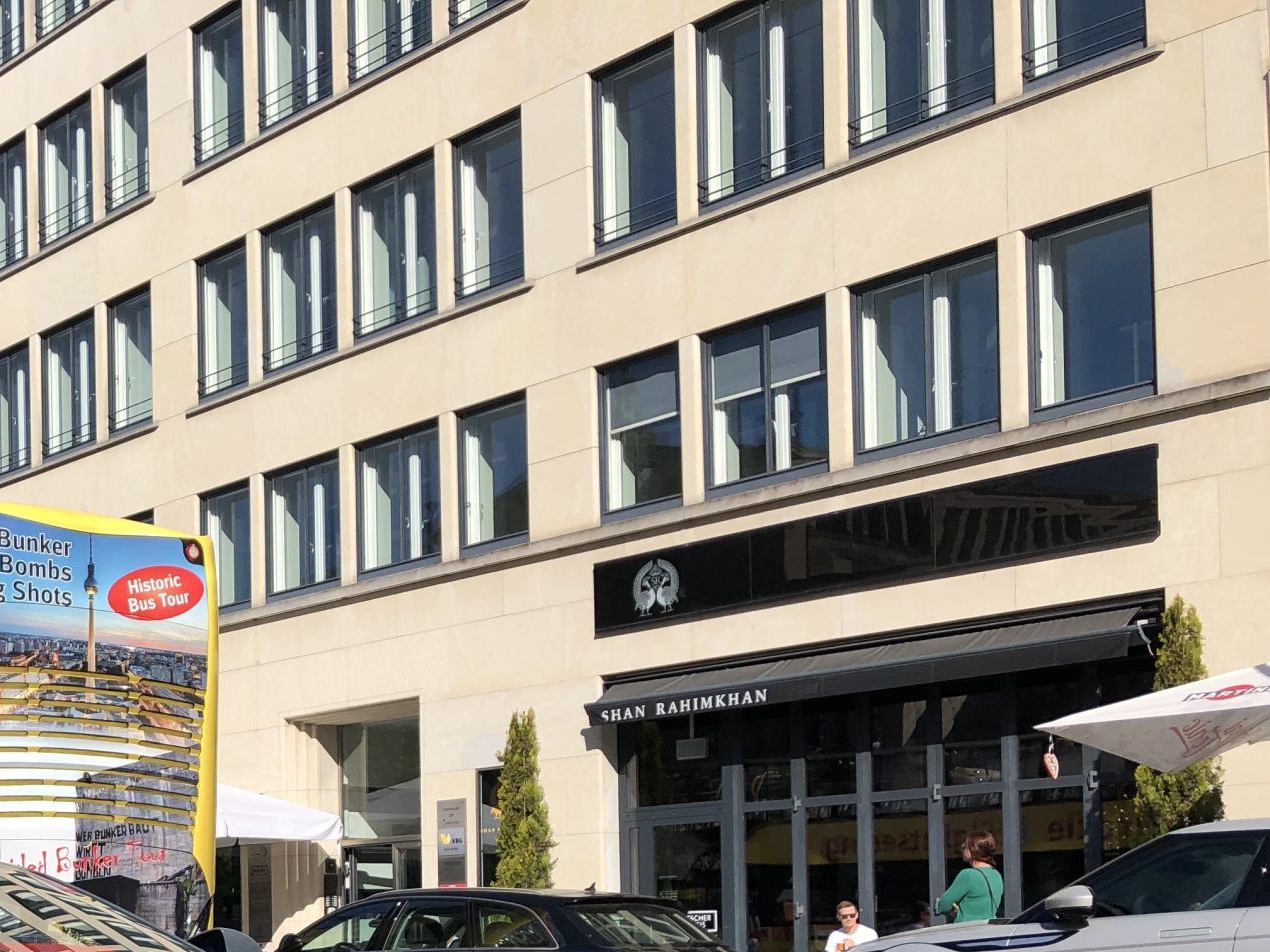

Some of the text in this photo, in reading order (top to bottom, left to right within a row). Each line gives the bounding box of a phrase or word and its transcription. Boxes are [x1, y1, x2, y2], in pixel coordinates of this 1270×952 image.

[0, 553, 72, 582] Bombs
[12, 580, 73, 607] Shots
[127, 573, 182, 595] Historic
[127, 590, 190, 613] Bus Tour
[601, 689, 768, 722] SHAN RAHIMKHAN
[76, 831, 92, 843] WER
[94, 825, 127, 840] BUNKER
[55, 844, 120, 873] Bunker
[126, 840, 168, 864] Tour
